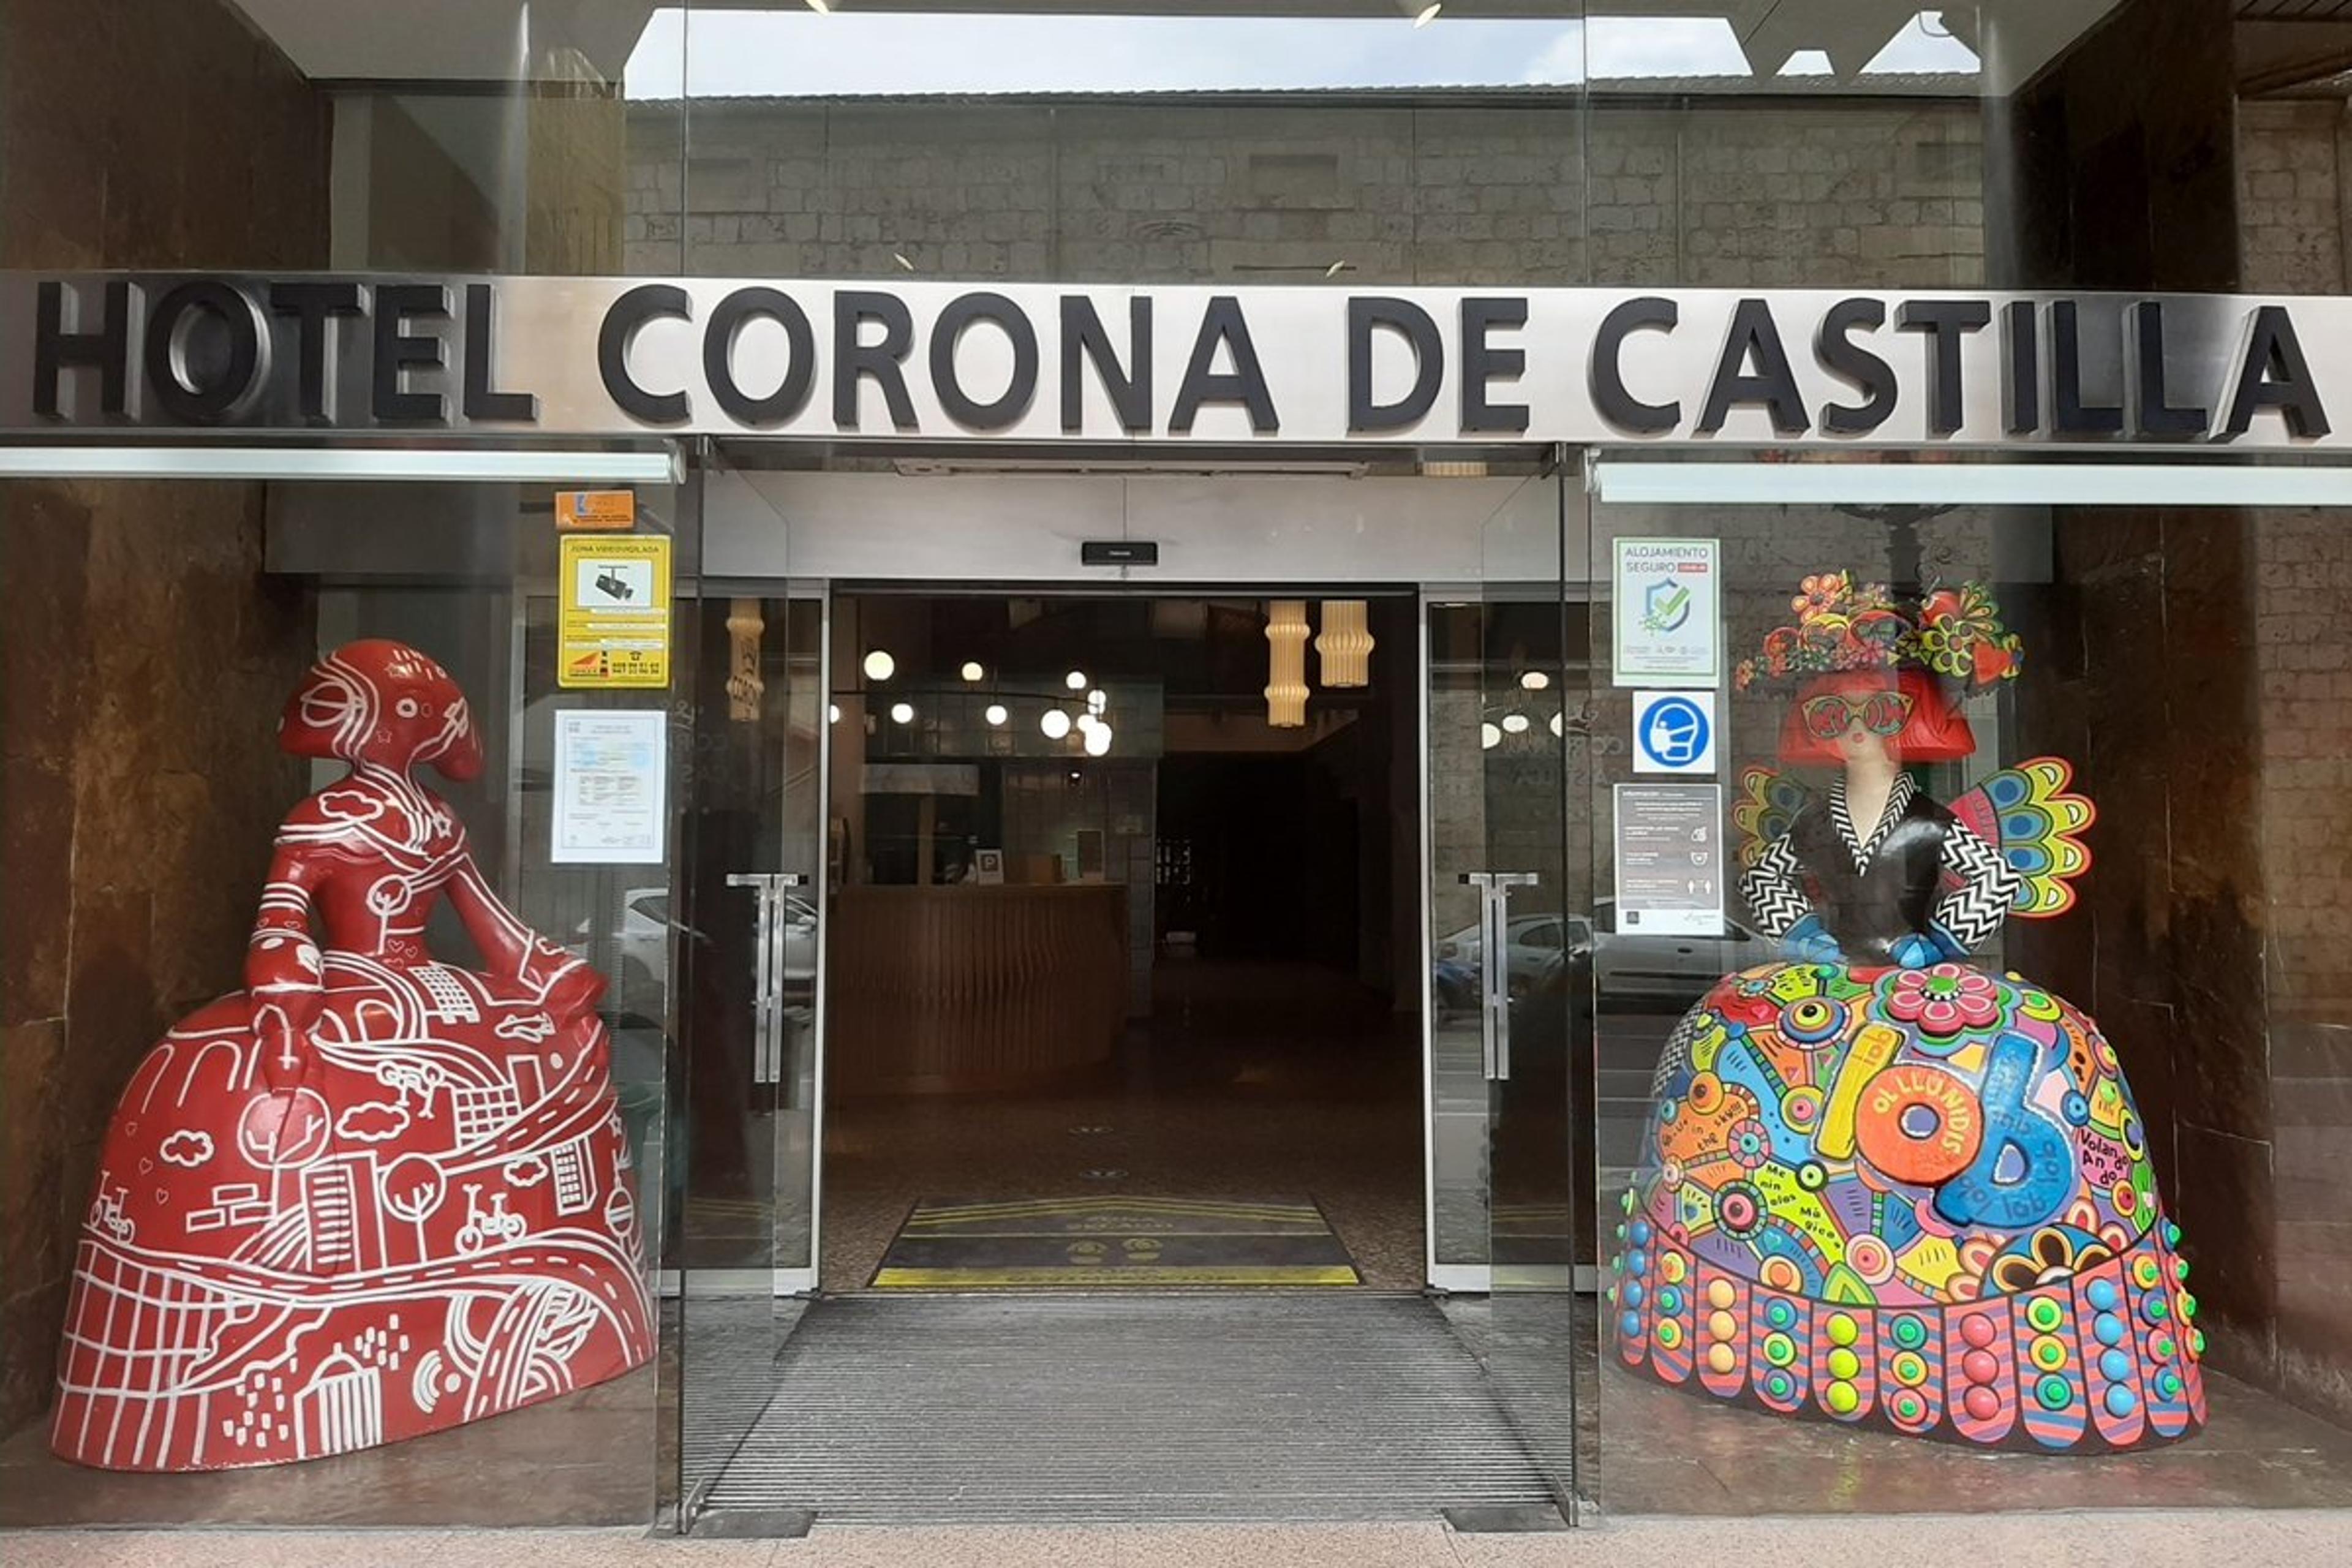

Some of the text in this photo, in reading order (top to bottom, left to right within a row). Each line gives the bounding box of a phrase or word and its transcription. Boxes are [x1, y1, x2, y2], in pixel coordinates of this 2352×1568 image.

[33, 281, 2331, 443] HOTEL CORONA DE CASTILLA
[1625, 546, 1708, 558] ALOJAMIENTO
[1626, 562, 1676, 573] SEGURO
